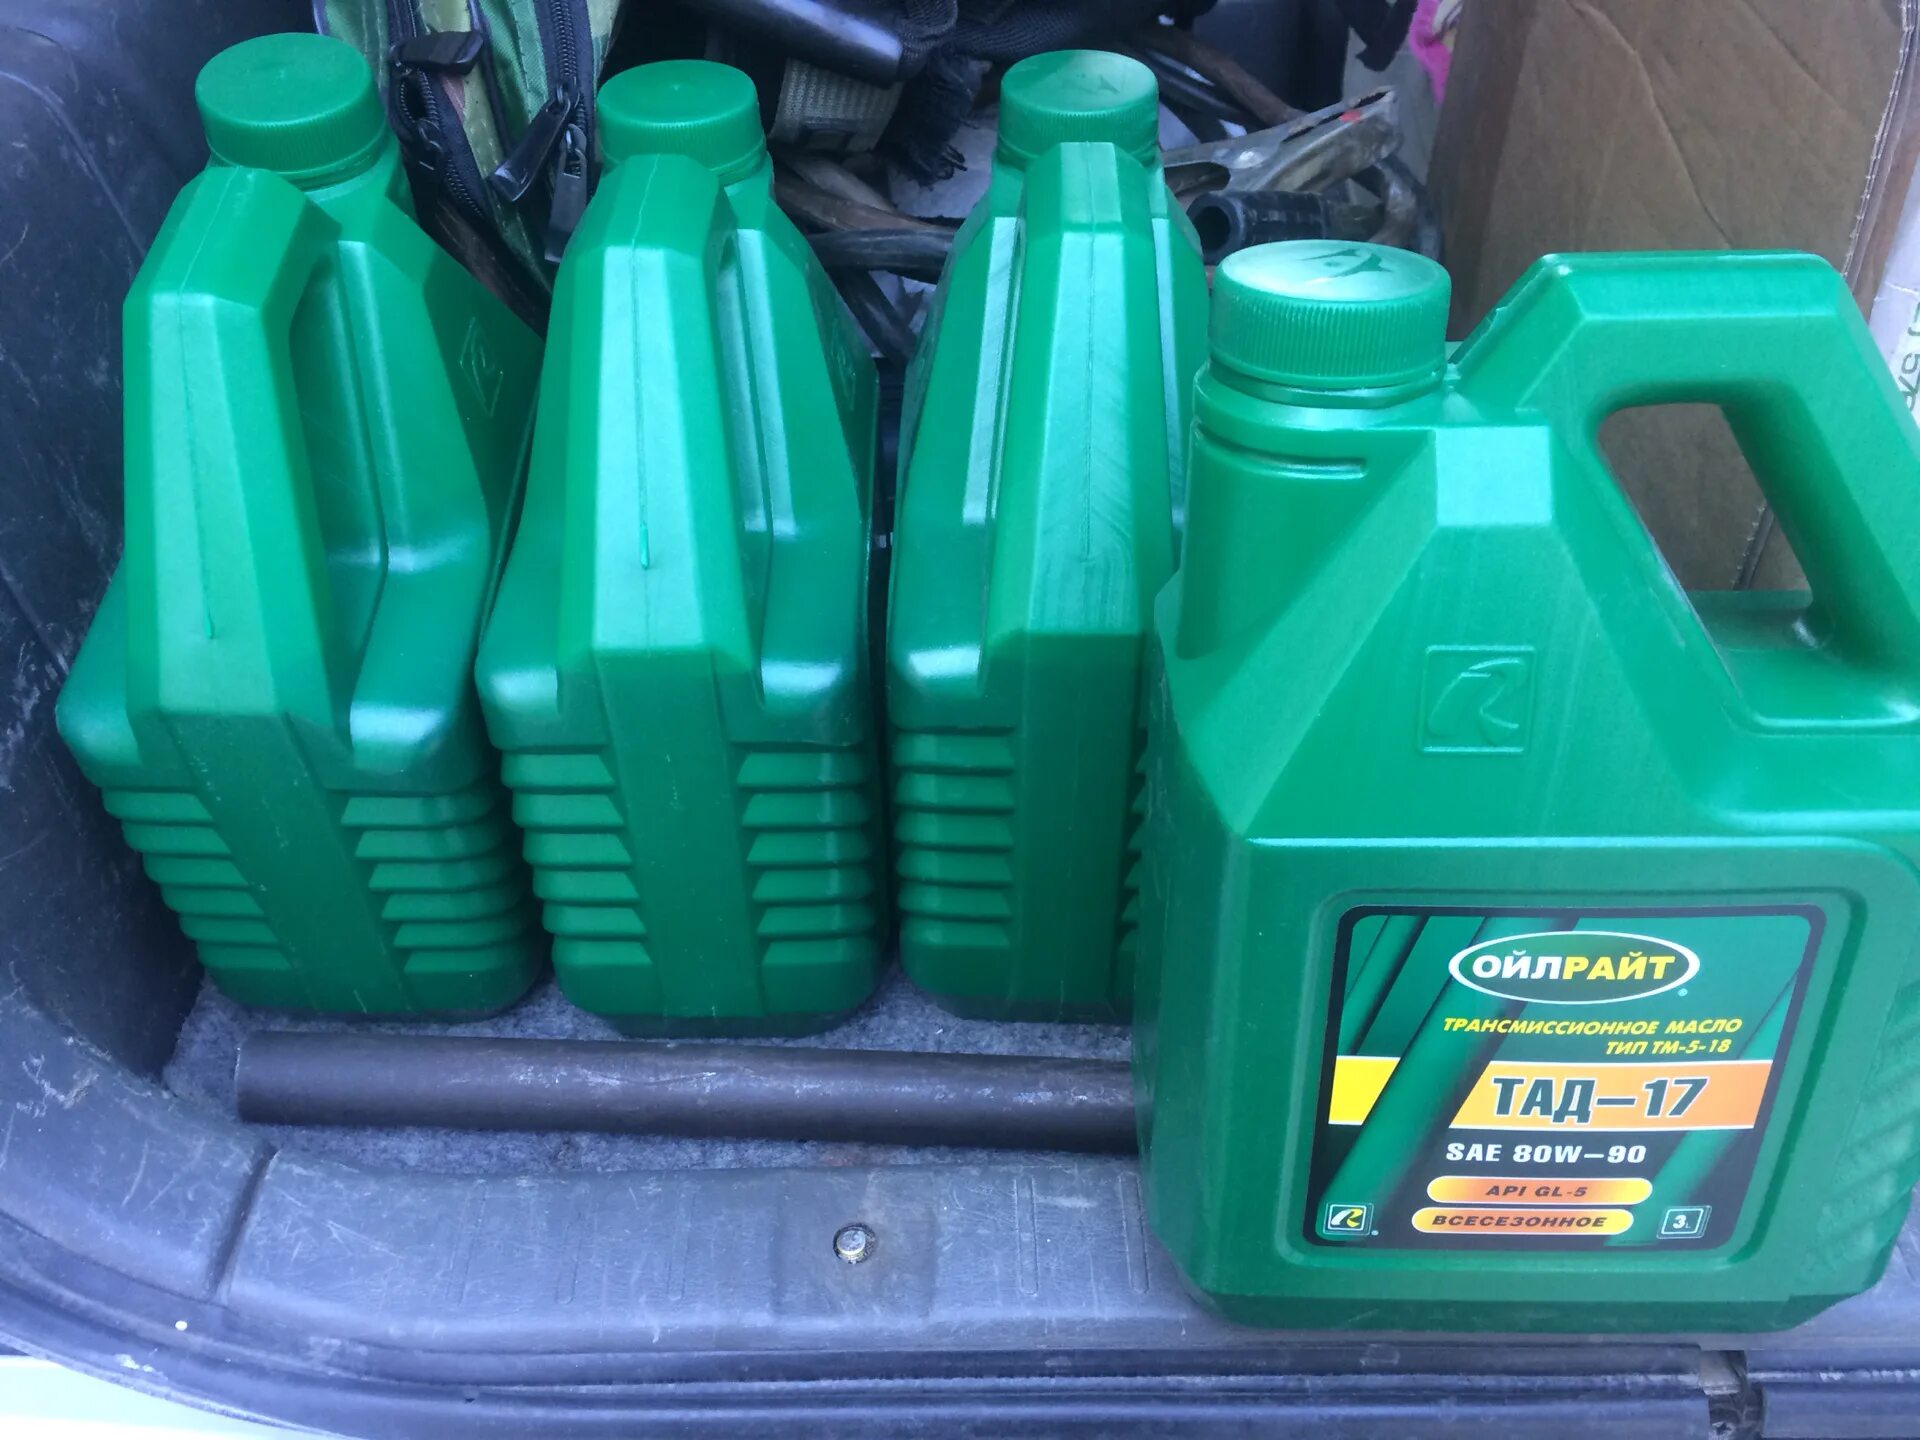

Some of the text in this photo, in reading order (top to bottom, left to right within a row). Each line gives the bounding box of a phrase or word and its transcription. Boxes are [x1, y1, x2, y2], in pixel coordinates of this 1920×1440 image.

[1472, 950, 1675, 980] ОЙЛРАЙТ
[1443, 1017, 1743, 1035] ТРАНСМИССИОННОЕ МАСЛО
[1606, 1041, 1646, 1055] ТИП
[1446, 1142, 1502, 1162] SAE
[1485, 1185, 1588, 1197] API GL-5
[1432, 1215, 1608, 1228] ВСЕСЕЗОННОЕ
